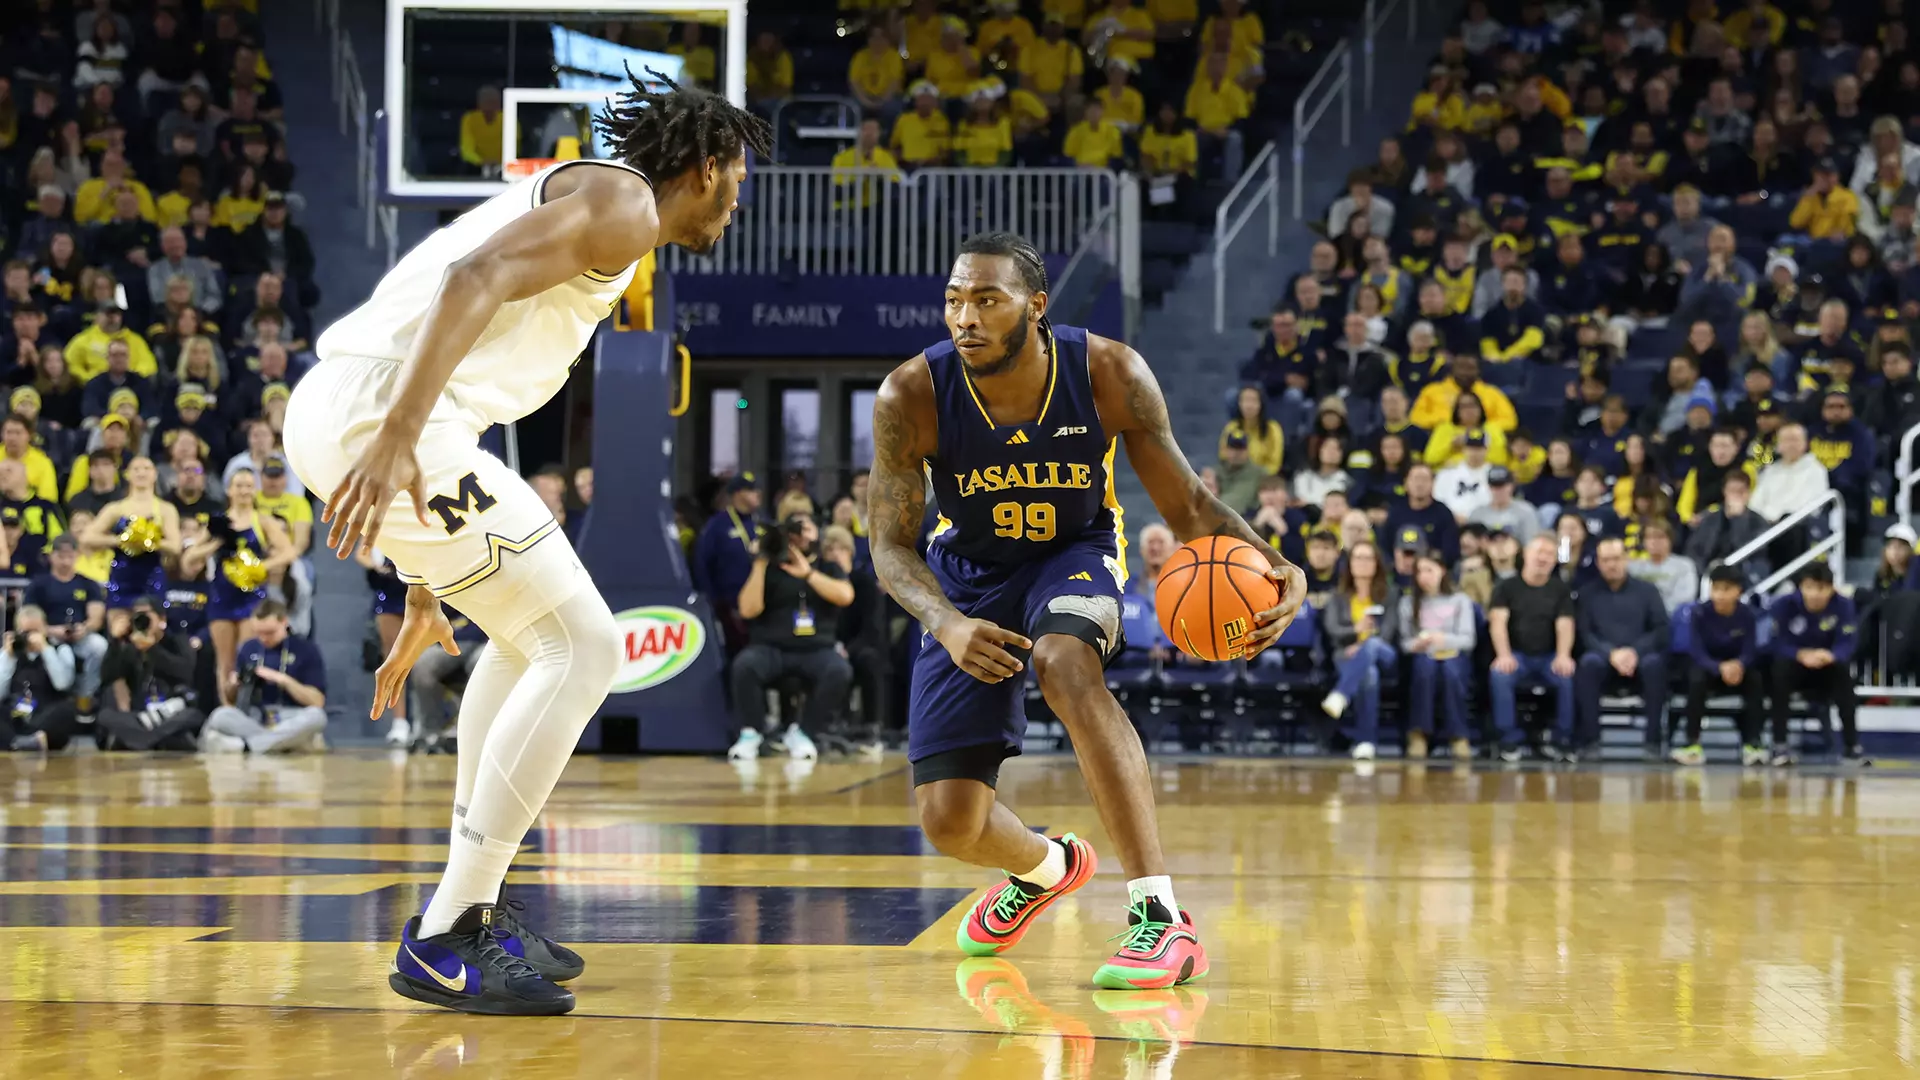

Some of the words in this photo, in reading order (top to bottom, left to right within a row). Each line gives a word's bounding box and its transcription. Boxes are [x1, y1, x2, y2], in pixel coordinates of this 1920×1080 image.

[752, 303, 843, 327] FAMILY
[1052, 425, 1088, 438] A10
[954, 461, 1092, 498] LASALLE
[427, 471, 498, 536] M
[992, 501, 1056, 542] 99
